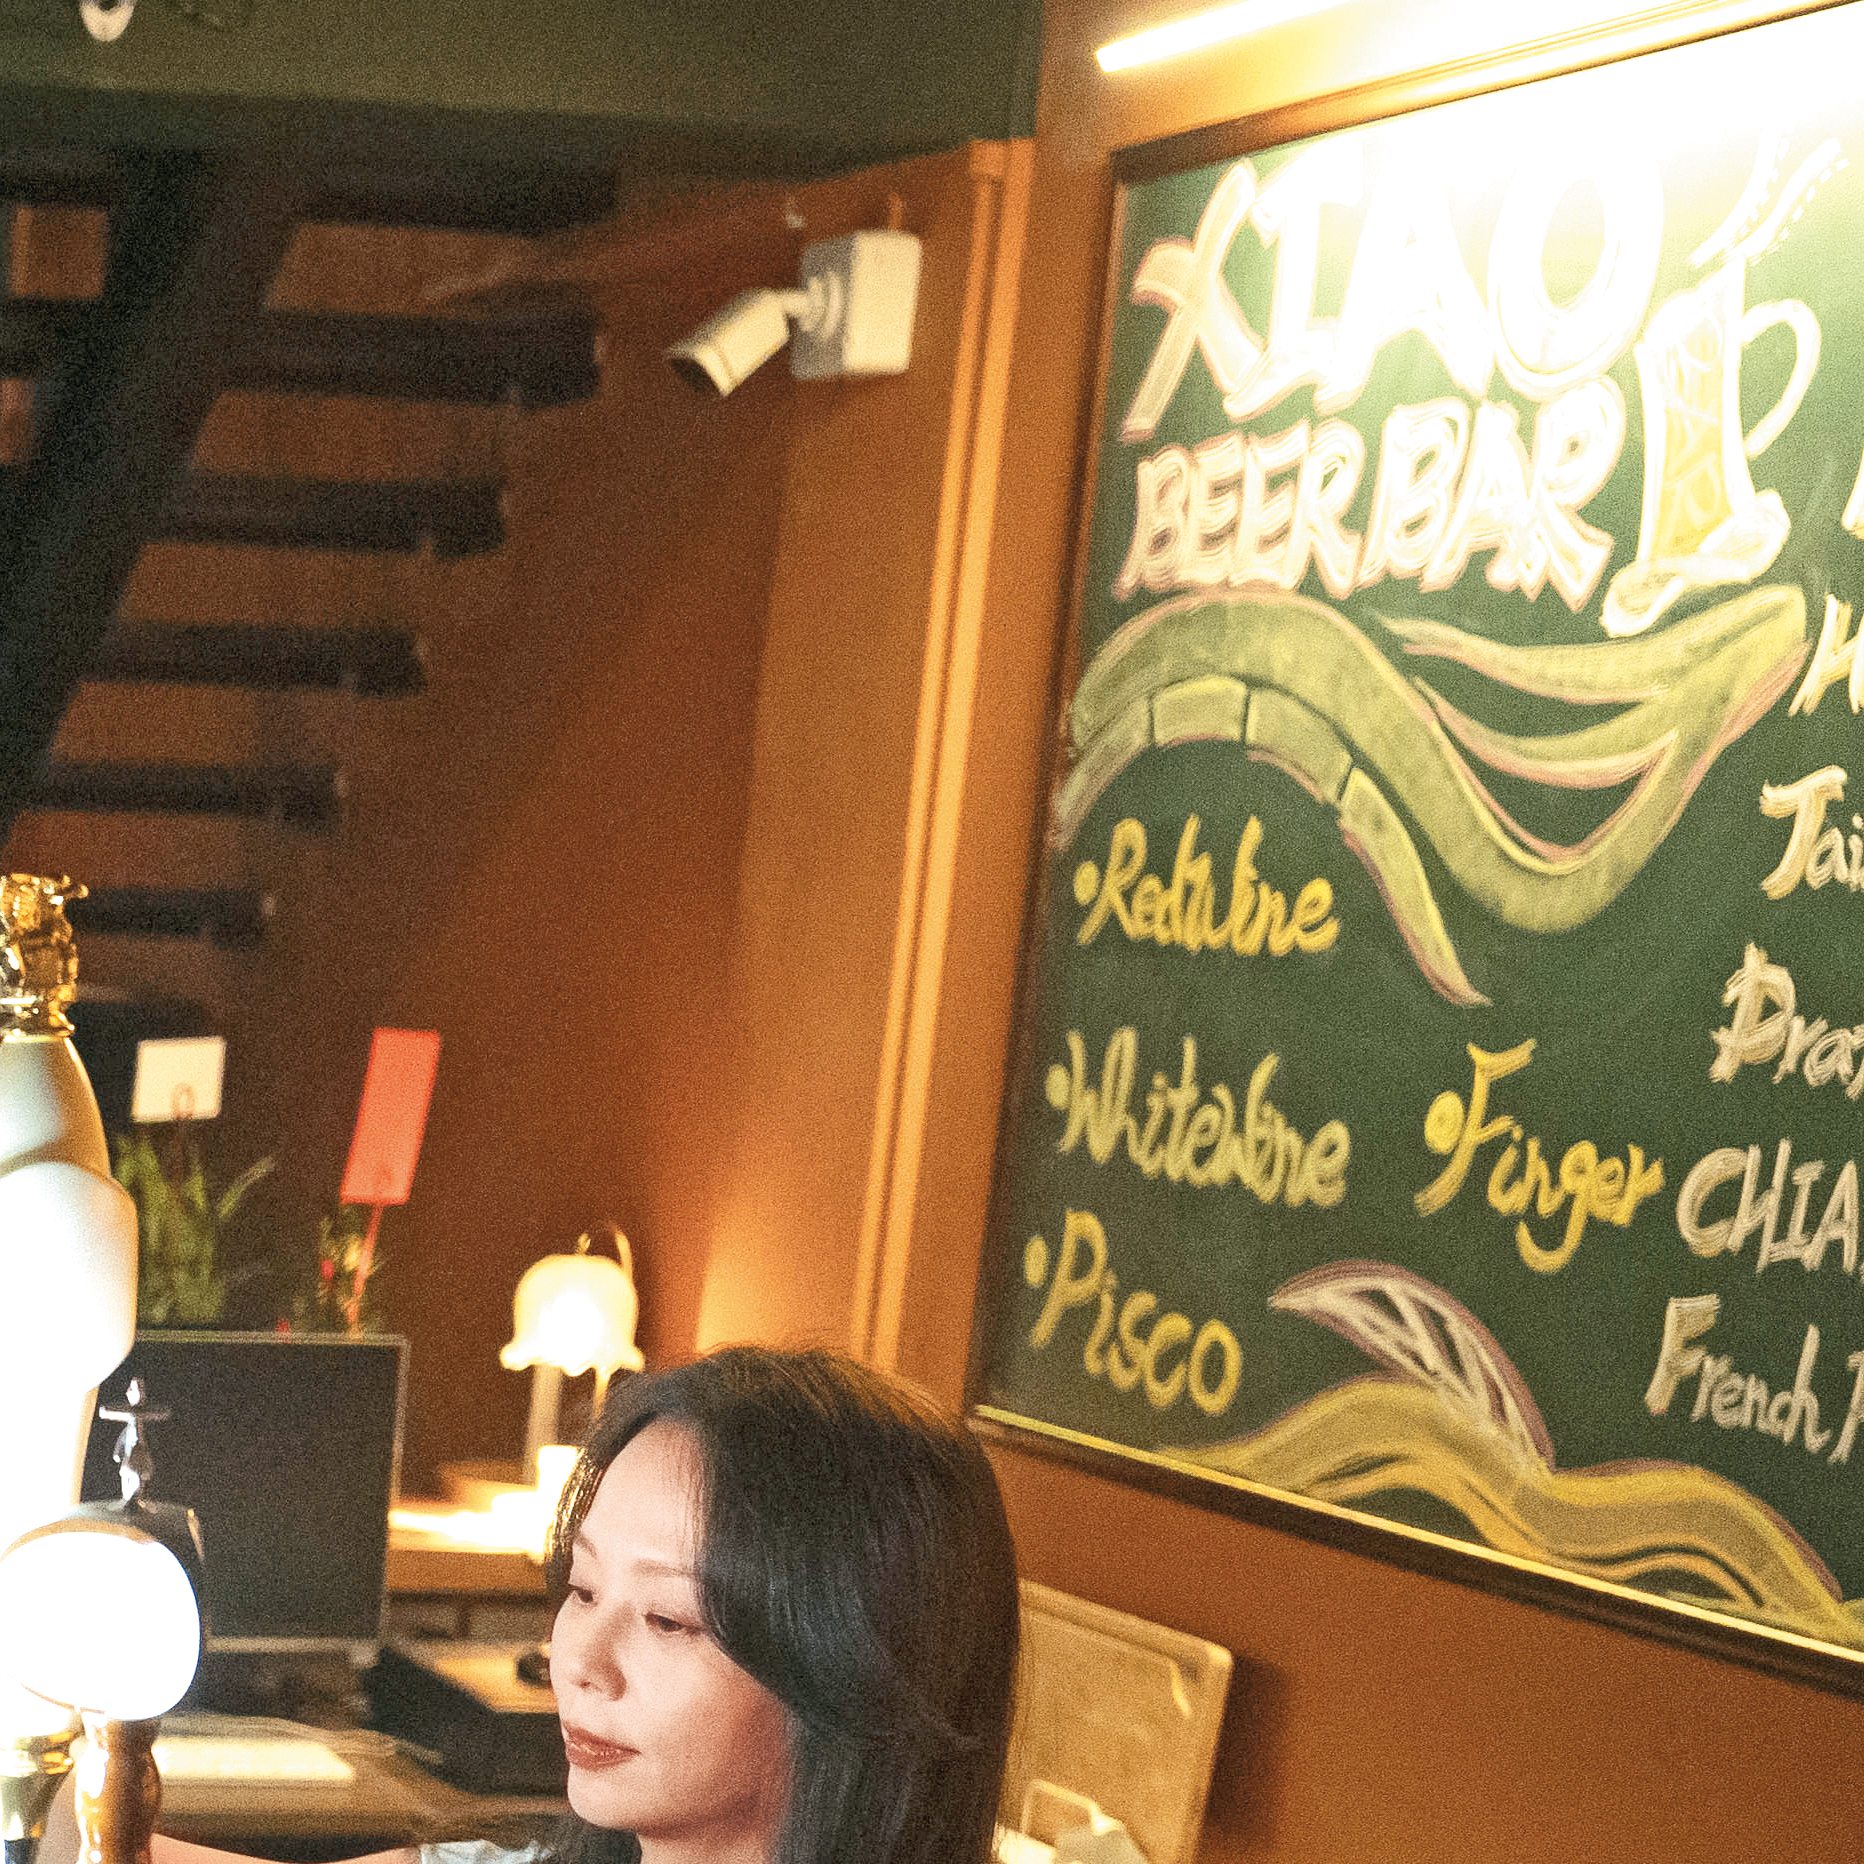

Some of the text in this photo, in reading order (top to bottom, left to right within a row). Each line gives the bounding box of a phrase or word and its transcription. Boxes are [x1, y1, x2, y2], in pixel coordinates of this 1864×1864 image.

[1119, 122, 1664, 445] XIAO
[1111, 376, 1627, 612] BEER BAR
[1413, 1037, 1667, 1275] Finger
[1675, 1136, 1864, 1286] CHIA
[1643, 1292, 1832, 1455] French
